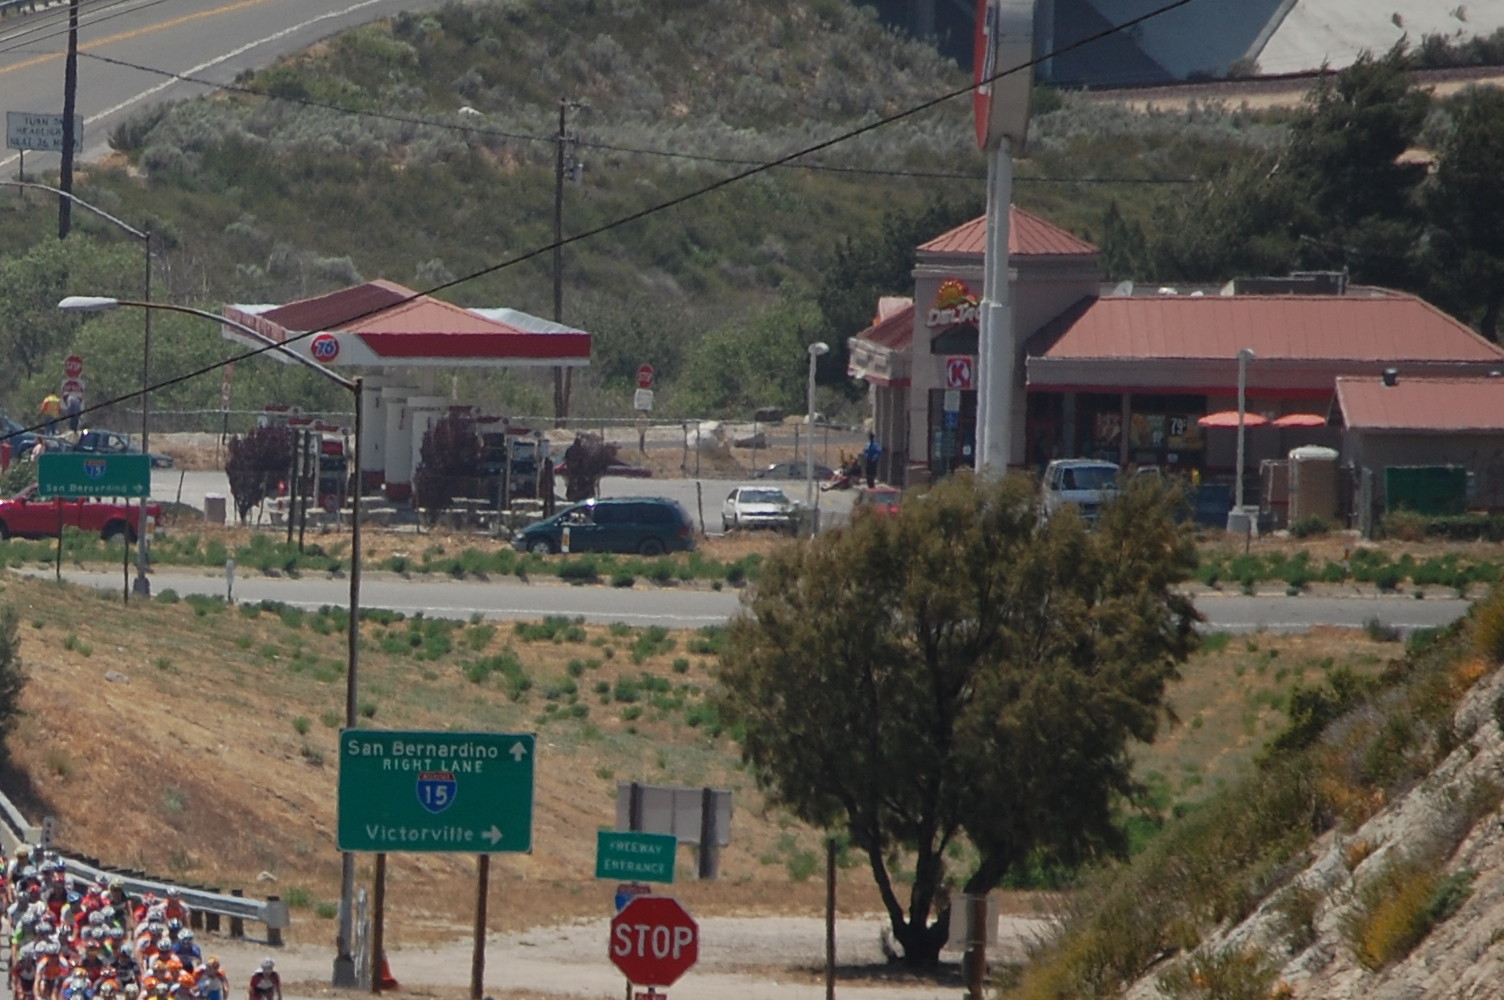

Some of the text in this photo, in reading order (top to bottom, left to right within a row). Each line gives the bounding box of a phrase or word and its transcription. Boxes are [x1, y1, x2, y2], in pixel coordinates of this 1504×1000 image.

[25, 117, 48, 126] TURN
[926, 307, 957, 327] DEL
[315, 340, 335, 357] 76
[46, 484, 127, 493] San Bernardino
[348, 740, 498, 758] San Bernardino
[383, 759, 483, 773] RIGHT LANE
[425, 784, 448, 806] 15
[366, 825, 474, 841] Victorville
[610, 839, 663, 854] FREEWAY
[604, 859, 665, 874] ENTRANCE
[614, 923, 694, 960] STOP
